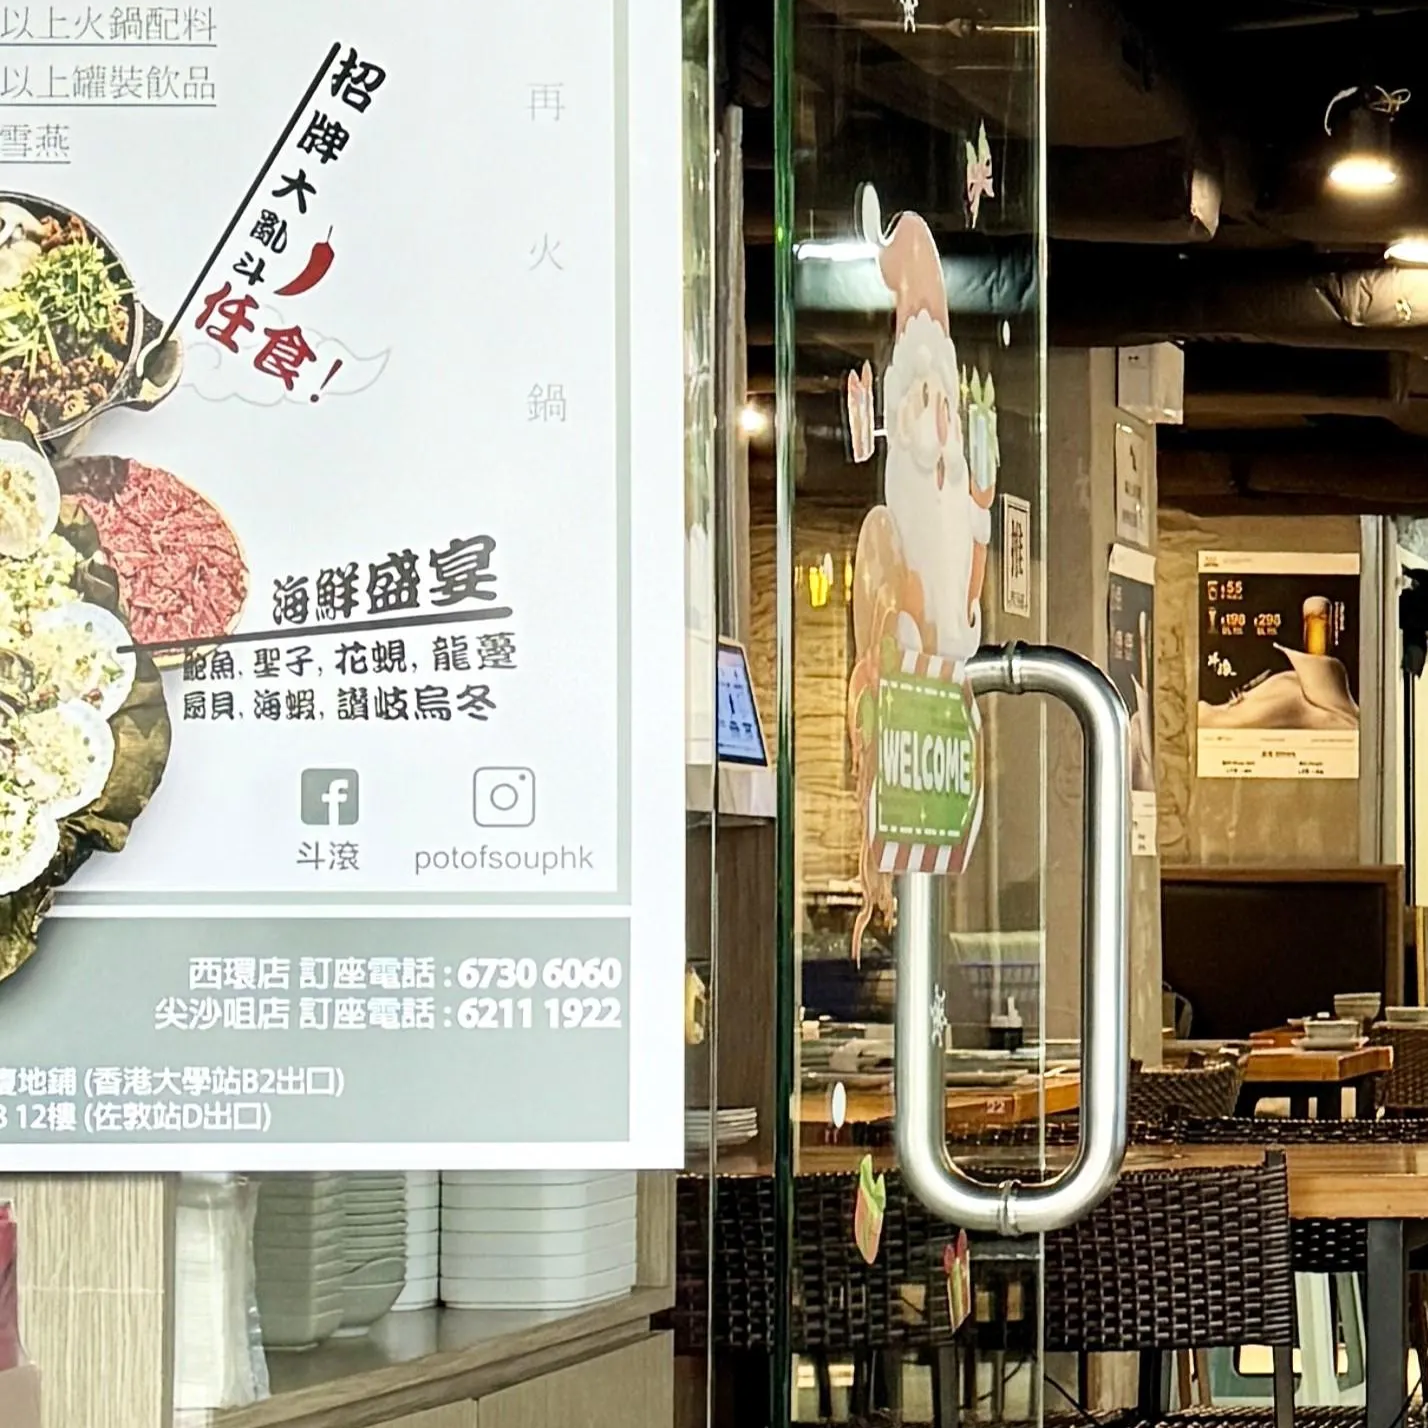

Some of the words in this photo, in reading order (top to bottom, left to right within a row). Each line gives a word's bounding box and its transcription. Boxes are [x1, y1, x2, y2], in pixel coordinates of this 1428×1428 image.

[272, 534, 497, 625] 海鮮盛宴
[883, 726, 971, 795] WELCOME
[415, 844, 594, 875] potofsouphk
[188, 957, 290, 990] 西環店
[456, 957, 538, 990] 6730
[542, 957, 622, 990] 6060
[154, 997, 290, 1030] 尖沙咀店
[457, 997, 533, 1030] 6211
[543, 997, 622, 1030] 1922
